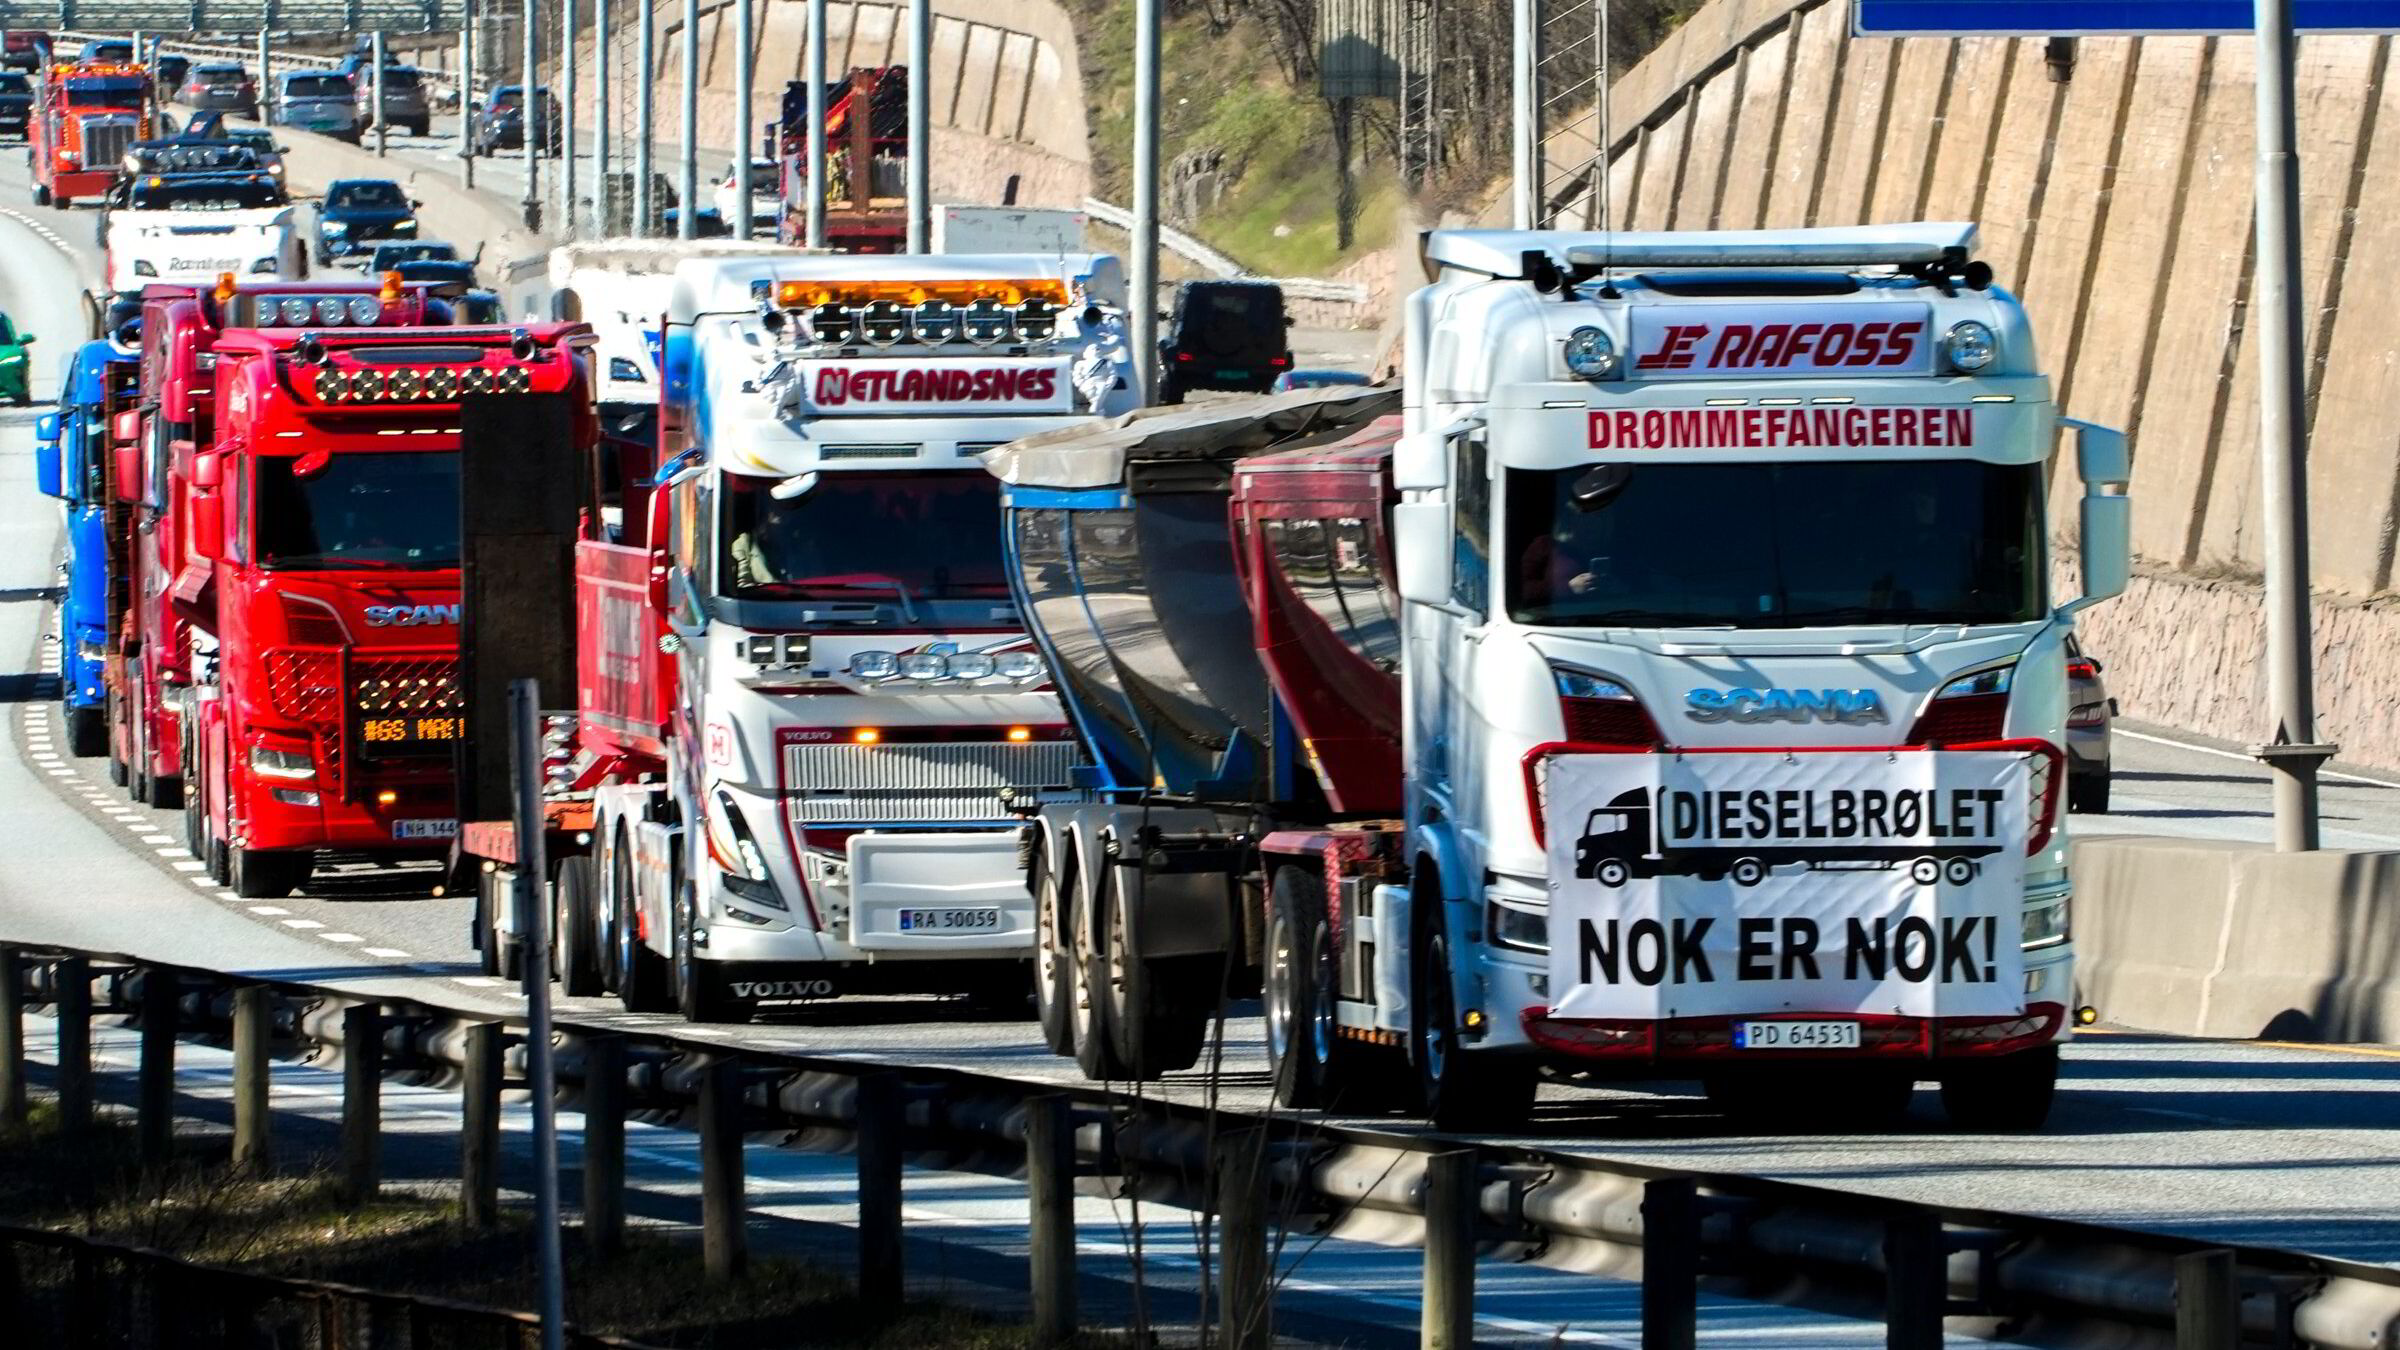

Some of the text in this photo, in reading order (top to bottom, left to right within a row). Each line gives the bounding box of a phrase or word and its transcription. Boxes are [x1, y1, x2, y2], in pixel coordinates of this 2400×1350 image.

[1707, 322, 1925, 369] RAFOSS
[1587, 408, 1973, 449] DRØMMEFANGEREN
[1684, 687, 1891, 726] SCANIA
[784, 731, 832, 740] VOLVO
[1672, 789, 2004, 839] DIESELBRØLET
[913, 910, 997, 928] RA 50059
[1579, 916, 1996, 986] NOK ER NOK!
[729, 980, 832, 998] VOLVO
[1750, 1024, 1856, 1044] PD 64531
